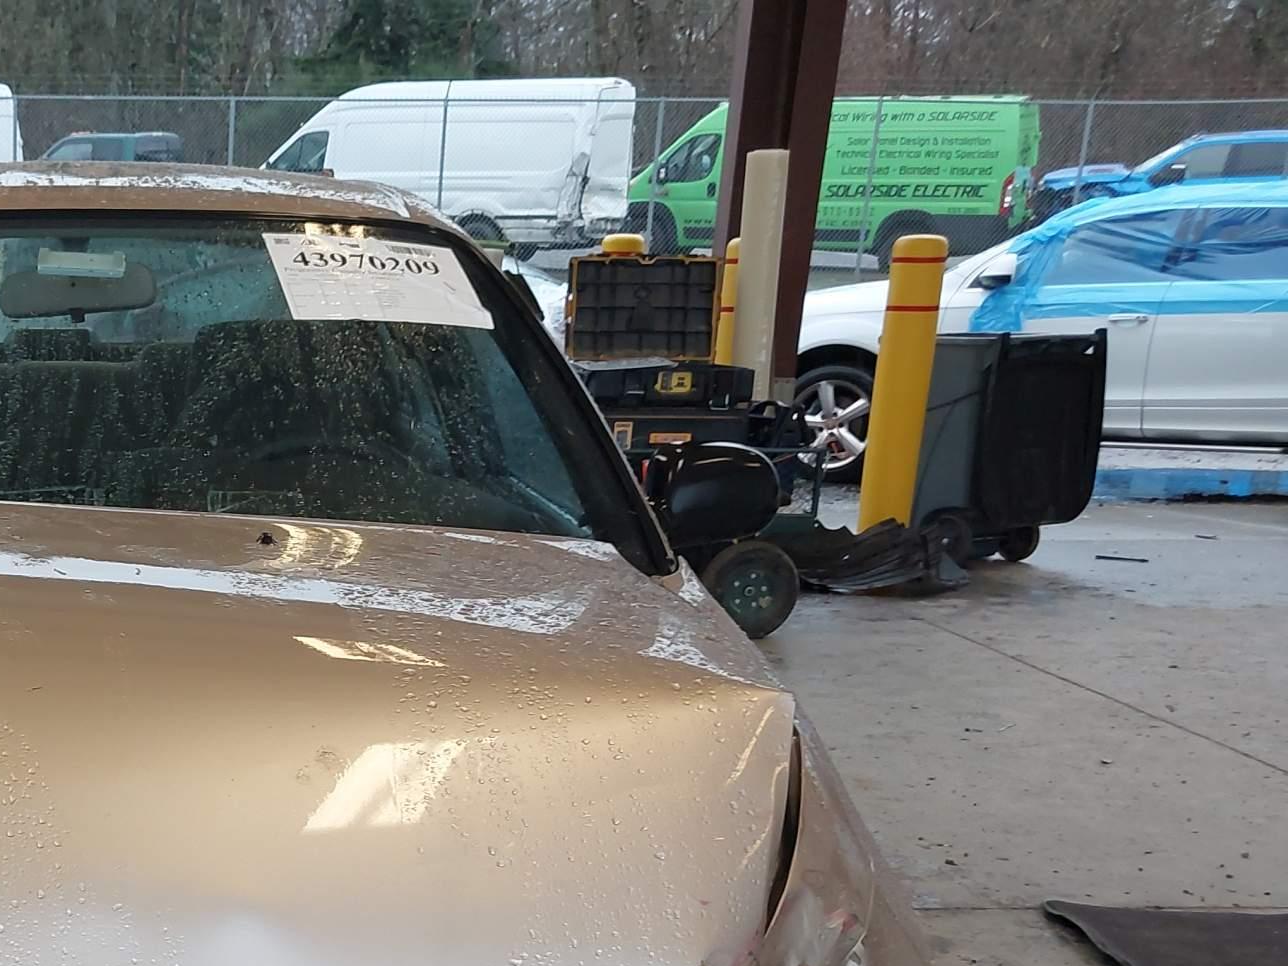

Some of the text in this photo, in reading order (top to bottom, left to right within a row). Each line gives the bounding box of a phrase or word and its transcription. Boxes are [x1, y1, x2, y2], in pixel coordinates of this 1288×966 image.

[927, 111, 999, 121] SOLARSIDE
[899, 165, 940, 175] Bonded
[949, 165, 993, 175] Insured
[912, 184, 989, 198] ELECTRIC
[293, 250, 440, 275] 43970209
